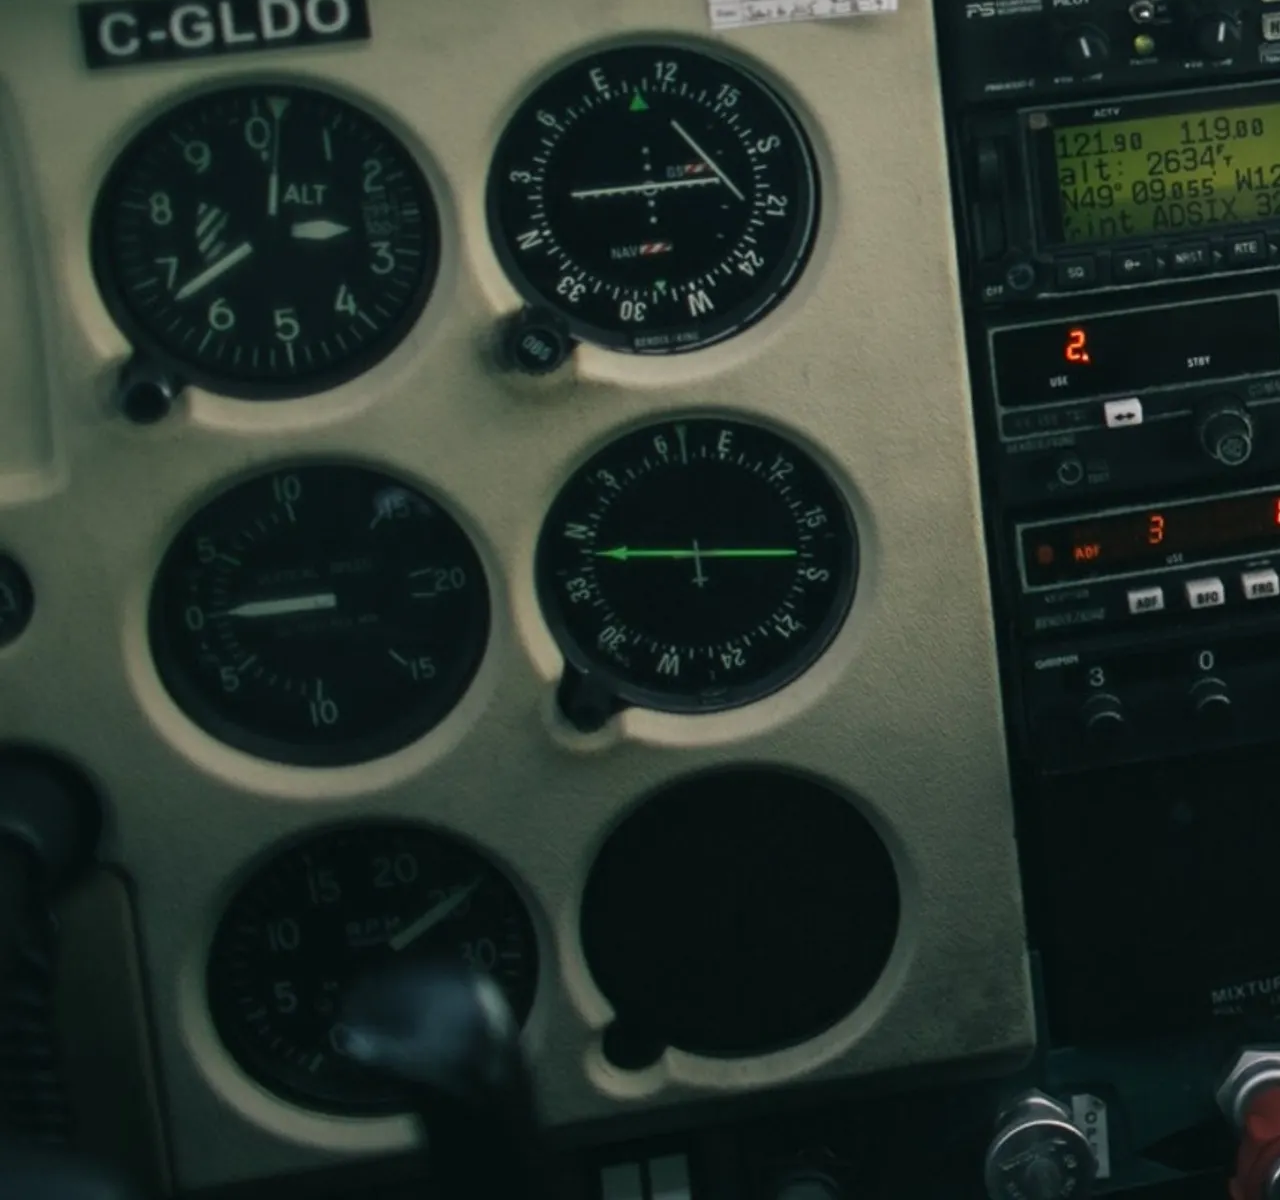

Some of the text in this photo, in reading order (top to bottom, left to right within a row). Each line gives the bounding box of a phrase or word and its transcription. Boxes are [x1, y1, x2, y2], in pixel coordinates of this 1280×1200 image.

[589, 67, 610, 92] E
[654, 61, 679, 83] 12
[718, 83, 743, 108] 15
[536, 108, 557, 128] 6
[244, 116, 270, 149] 0
[756, 134, 781, 153] S
[1059, 117, 1265, 157] 121.90 119.00
[183, 139, 211, 174] 9
[362, 159, 385, 192] 2
[509, 169, 532, 185] 3
[1060, 158, 1123, 185] alt:
[282, 183, 327, 207] ALT
[766, 193, 788, 217] 21
[149, 191, 174, 226] 8
[1153, 199, 1239, 230] ADSIX
[516, 228, 544, 250] N
[1234, 240, 1257, 256] RTE
[369, 240, 396, 275] 3
[611, 244, 640, 260] NAV
[737, 249, 765, 277] 24
[154, 256, 178, 290] 7
[333, 279, 358, 316] 4
[556, 274, 586, 302] 33
[208, 297, 236, 332] 6
[619, 301, 647, 322] 30
[687, 289, 716, 318] W
[272, 306, 300, 342] 5
[1186, 355, 1211, 368] STBY
[1049, 375, 1069, 388] USE
[652, 434, 668, 455] 6
[717, 429, 734, 453] E
[596, 468, 616, 489] 3
[770, 455, 795, 482] 12
[272, 475, 300, 504] 10
[562, 521, 589, 541] N
[802, 506, 828, 531] 15
[1147, 512, 1165, 544] 3
[197, 538, 216, 563] 5
[1072, 543, 1100, 562] ADF
[434, 565, 466, 591] 20
[806, 566, 830, 583] S
[564, 576, 590, 604] 33
[1136, 596, 1158, 609] ADF
[185, 606, 204, 632] 0
[773, 614, 800, 640] 21
[599, 626, 626, 653] 30
[408, 656, 436, 680] 15
[655, 652, 681, 677] W
[720, 647, 747, 670] 24
[1199, 650, 1215, 670] 0
[219, 667, 240, 692] 5
[1089, 667, 1105, 687] 3
[309, 700, 339, 727] 10
[373, 853, 419, 888] 20
[308, 870, 342, 904] 15
[267, 919, 300, 950] 10
[346, 916, 400, 938] RPM
[274, 982, 298, 1014] 5
